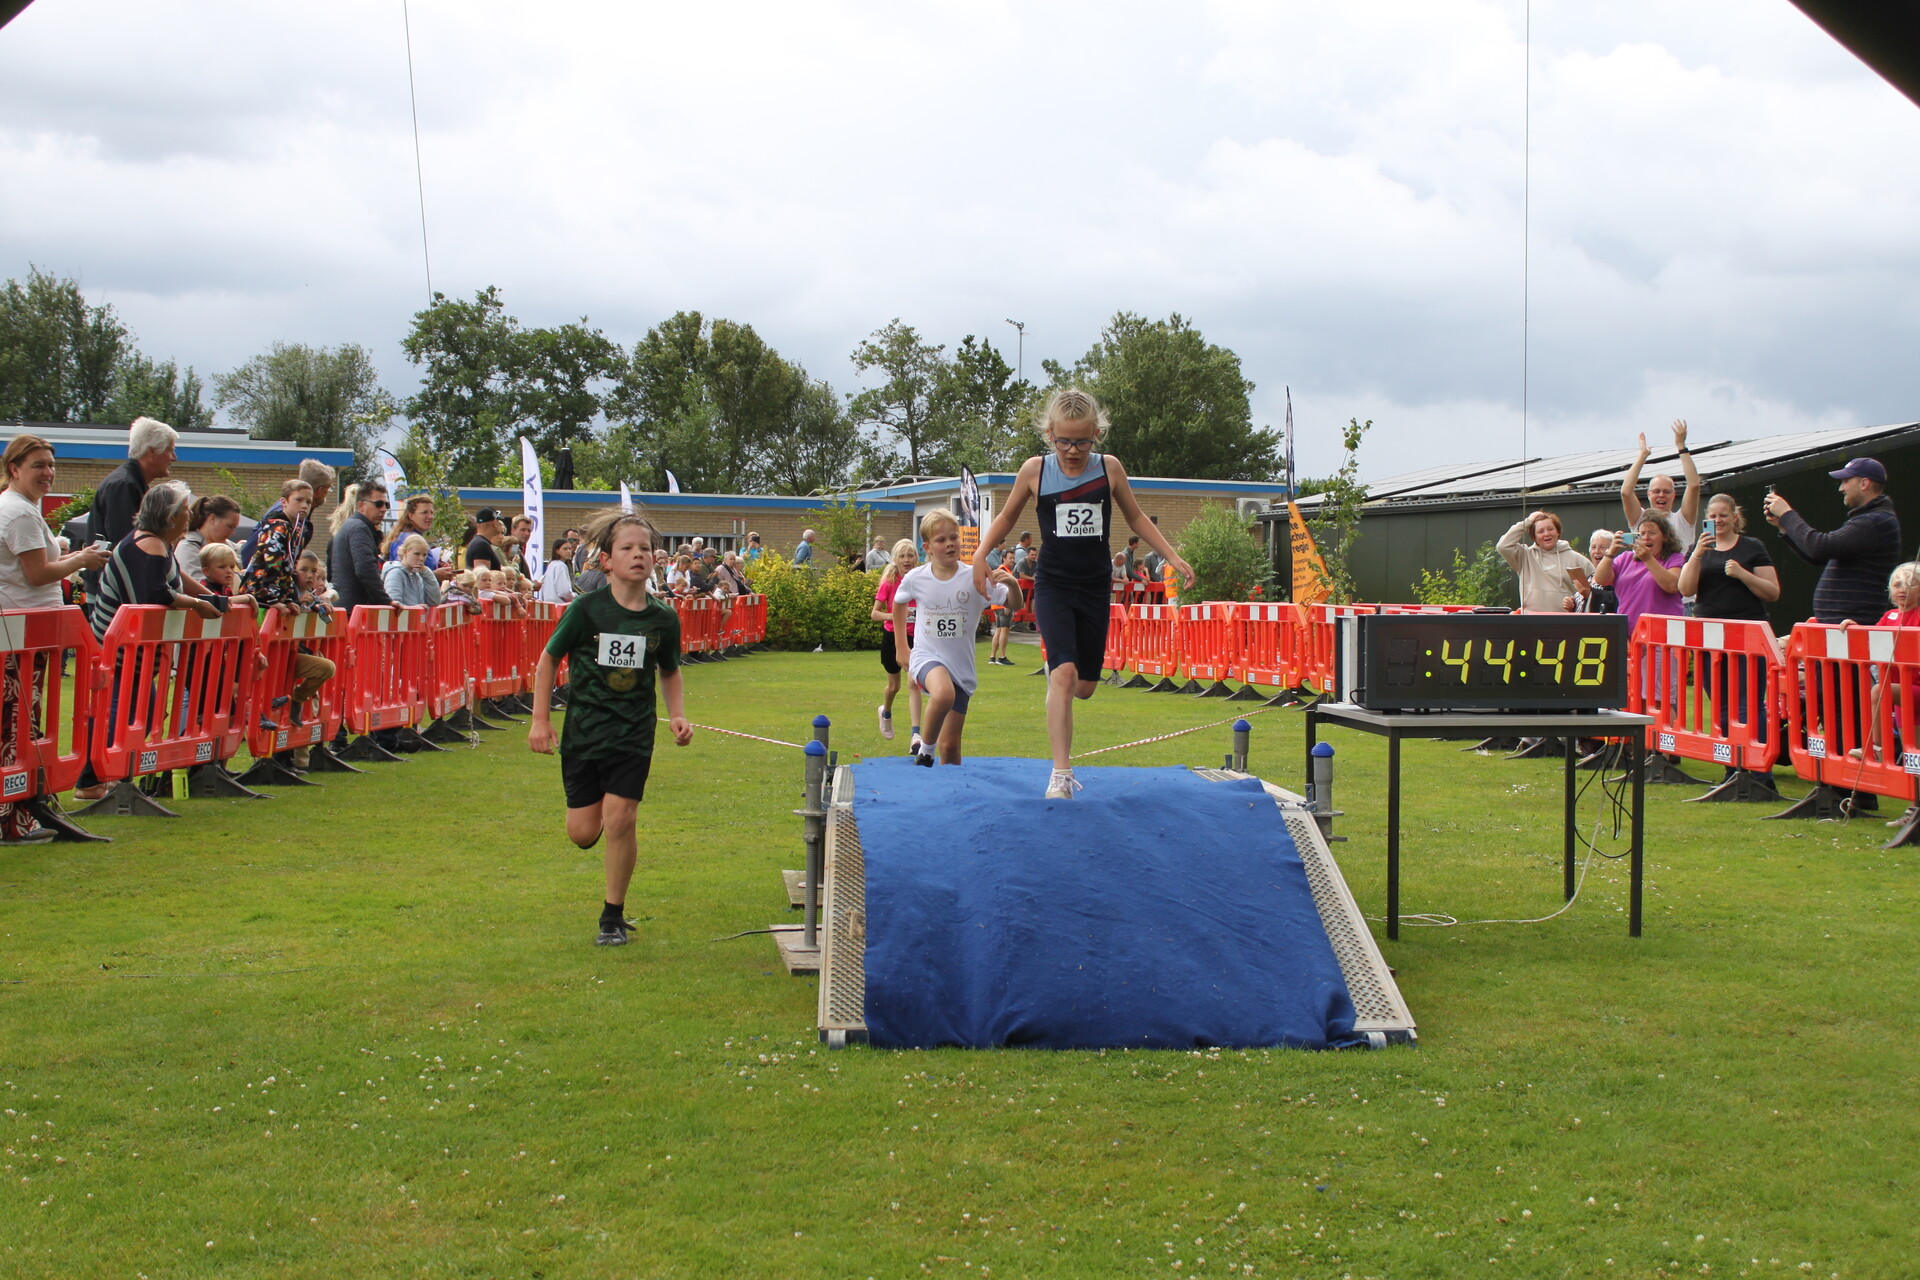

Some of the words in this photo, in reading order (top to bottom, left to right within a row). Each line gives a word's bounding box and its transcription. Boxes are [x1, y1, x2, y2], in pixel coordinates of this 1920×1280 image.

[1067, 508, 1094, 526] 52
[937, 619, 956, 631] 65
[937, 630, 956, 638] Dave
[609, 640, 636, 657] 84
[608, 656, 636, 666] Noah
[1659, 733, 1675, 747] RECO
[1808, 737, 1826, 753] RECO
[196, 742, 212, 755] RECO
[1713, 744, 1731, 757] RECO
[140, 752, 157, 765] RECO
[4, 775, 26, 789] RECO
